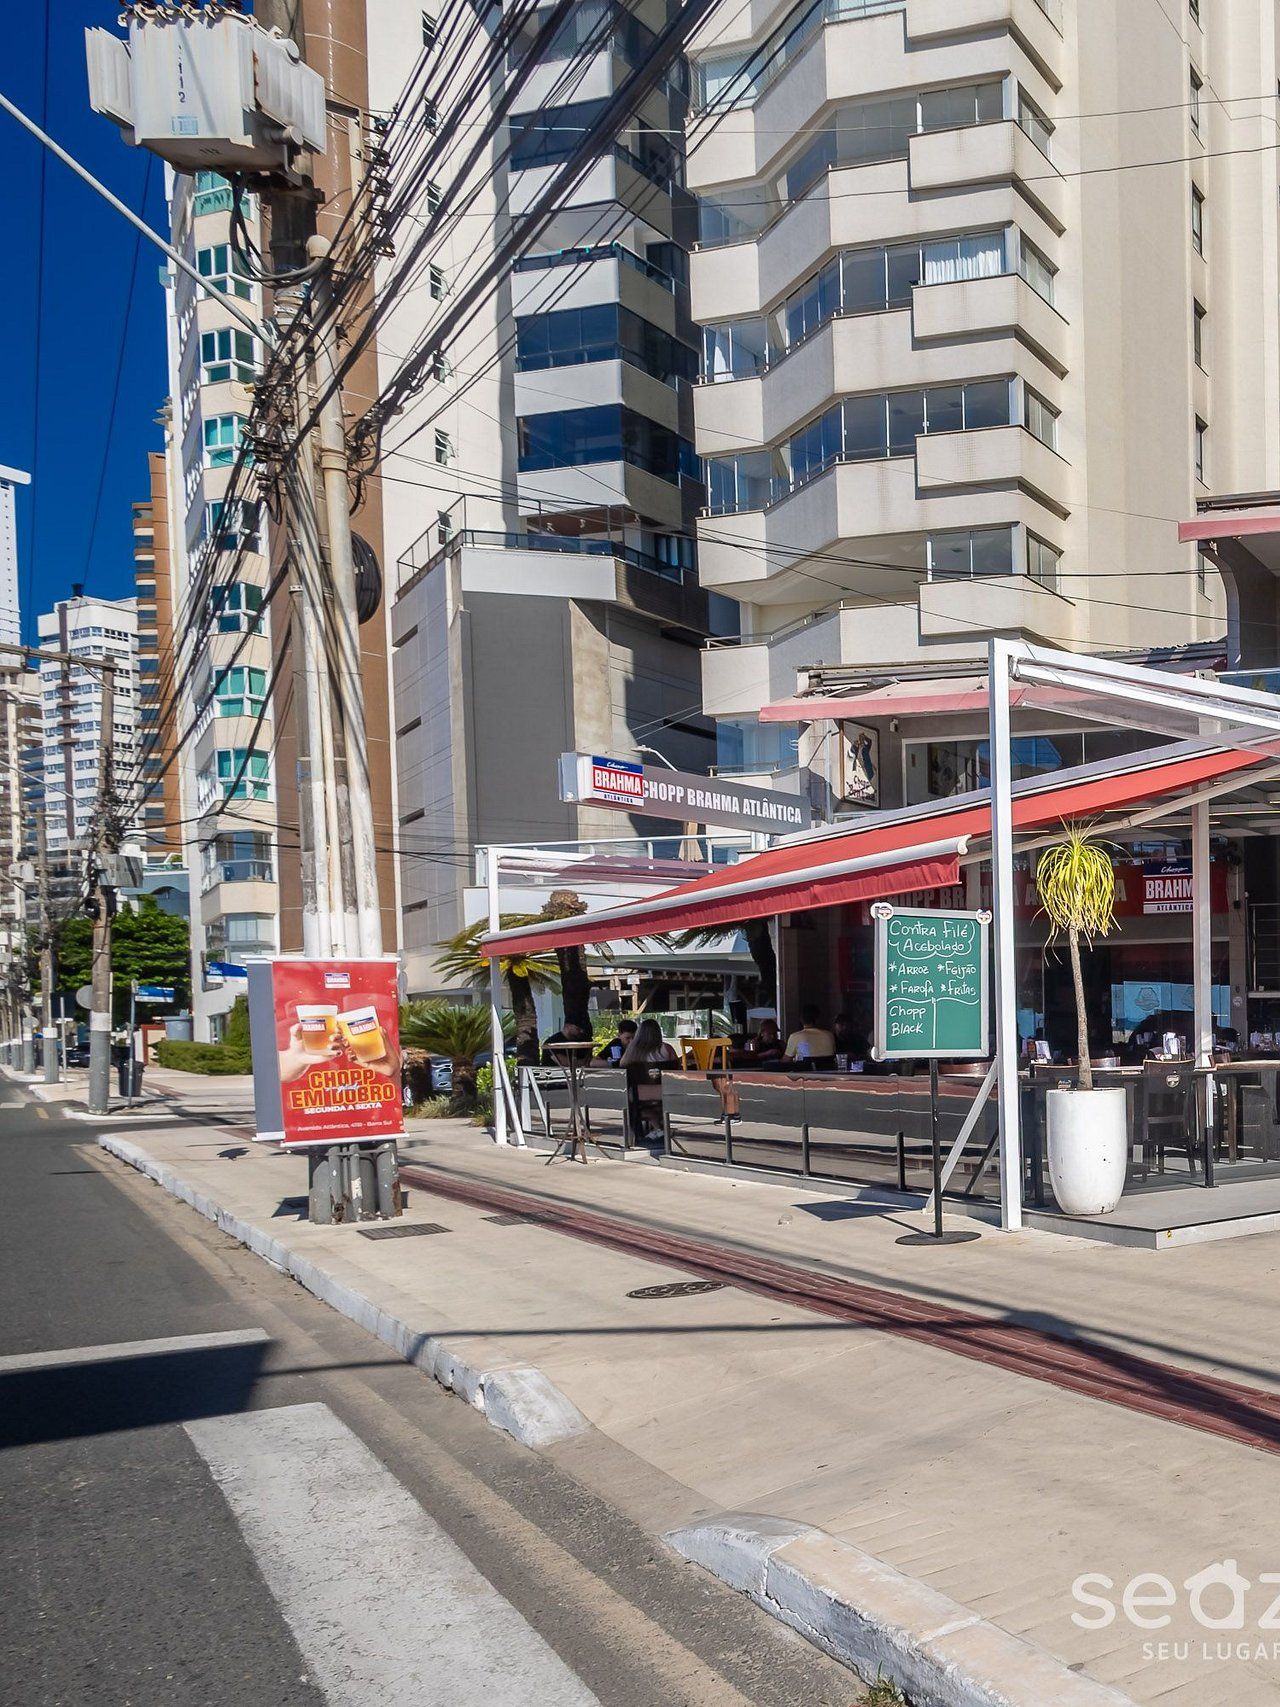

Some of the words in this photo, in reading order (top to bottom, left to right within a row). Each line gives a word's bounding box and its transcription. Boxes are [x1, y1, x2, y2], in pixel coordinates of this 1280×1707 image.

[595, 770, 642, 795] BRAHMA
[642, 779, 684, 803] CHOPP
[687, 788, 740, 814] BRAHMA
[743, 798, 802, 824] ATLÂNTICA
[1146, 878, 1193, 899] BRAHM
[309, 1069, 375, 1089] CHOPP
[290, 1090, 325, 1109] EM
[332, 1083, 396, 1105] DOBRO
[304, 1105, 346, 1115] SEGUNDA
[355, 1102, 382, 1110] SEXTA
